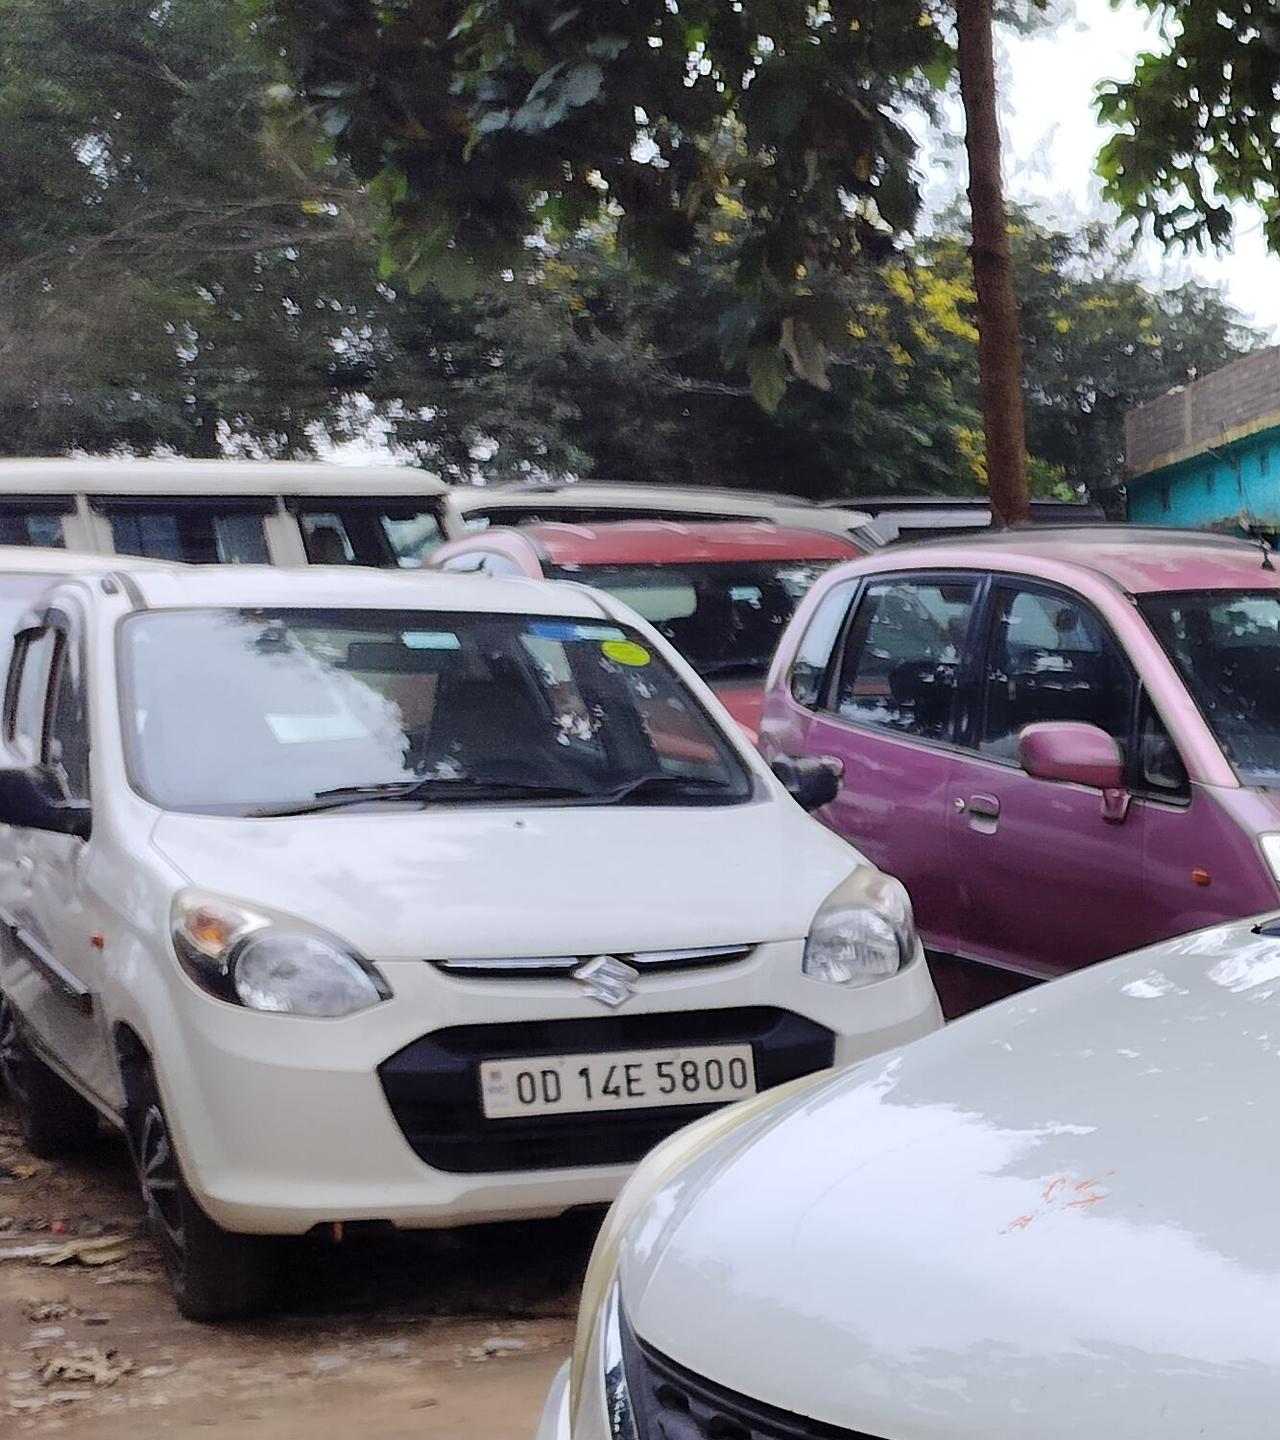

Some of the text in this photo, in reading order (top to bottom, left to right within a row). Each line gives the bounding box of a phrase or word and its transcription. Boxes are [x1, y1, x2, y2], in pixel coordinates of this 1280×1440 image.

[516, 1057, 748, 1105] OD 14E 5800
